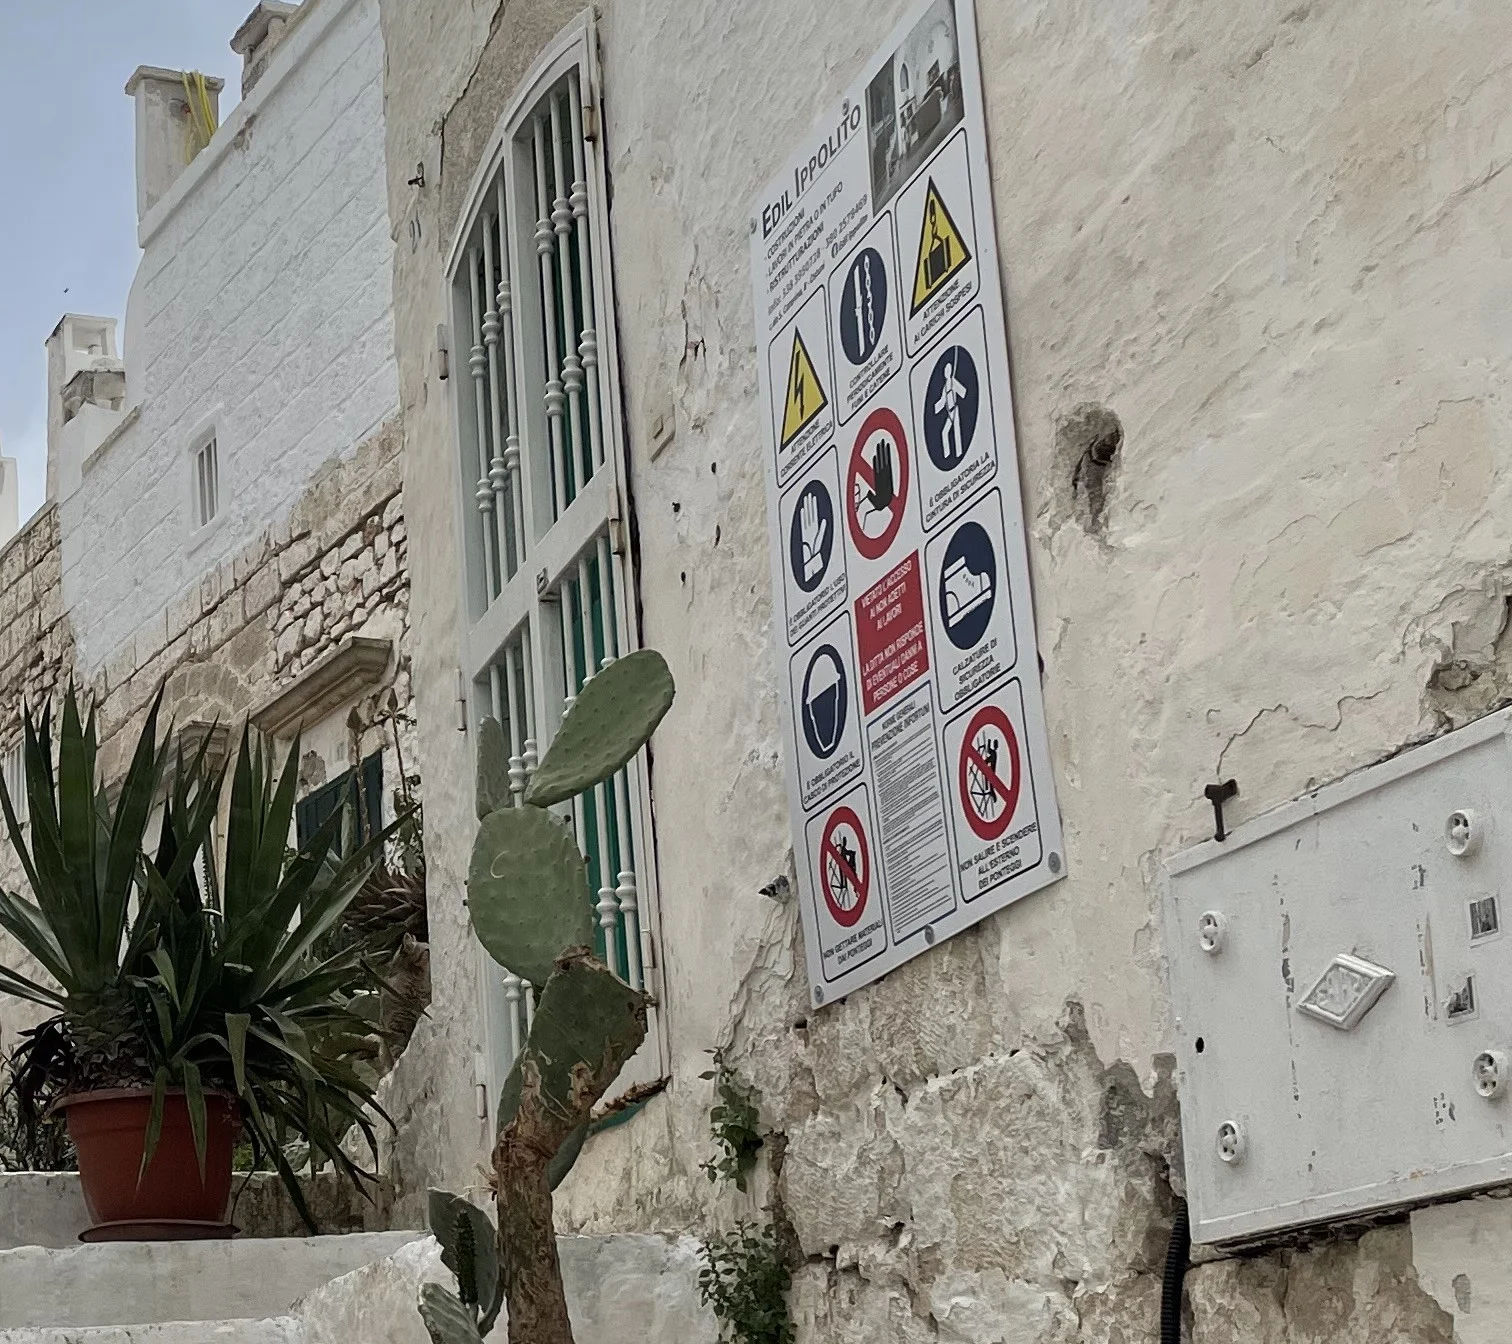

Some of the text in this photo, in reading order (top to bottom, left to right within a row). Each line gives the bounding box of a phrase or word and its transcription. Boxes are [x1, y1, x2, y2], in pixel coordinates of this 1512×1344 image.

[767, 208, 804, 260] COSTRUZIONI
[768, 248, 787, 277] LAVORI
[787, 240, 793, 254] IN
[794, 216, 813, 246] PIETRA
[819, 200, 826, 215] IN
[826, 180, 843, 207] TUFO
[769, 221, 824, 293] RISTRUTTURAZIONI
[913, 278, 972, 345] AI CARICHI SOSPESI
[922, 275, 960, 322] ATTENZIONE
[846, 350, 893, 405] PERIODICAMENTE
[849, 343, 888, 390] CONTROLLARE
[851, 392, 863, 412] FUNI
[868, 365, 890, 394] CATENE
[790, 417, 819, 455] ATTENZIONE
[806, 418, 832, 453] ELETTRICA
[925, 457, 995, 524] CINTURA DI SICUREZZA
[934, 456, 979, 504] OBBLIGATORIA
[979, 448, 989, 465] LA
[861, 582, 882, 610] VIETATO
[882, 600, 902, 627] LAVORI
[895, 618, 923, 651] RISPONDE
[872, 654, 900, 687] EVENTUALI
[952, 636, 997, 677] CALZATURE DI
[958, 652, 994, 686] SICUREZZA
[872, 674, 898, 704] PERSONE
[902, 658, 918, 681] COSE
[954, 661, 1001, 702] OBBLIGATORIE
[827, 757, 860, 788] PROTEZIONE
[959, 857, 973, 873] NON
[973, 843, 995, 865] SALIRE
[1001, 820, 1036, 850] SCENDERE
[978, 857, 1022, 890] DEI PONTEGGI
[834, 933, 857, 953] GETTARE
[847, 937, 872, 959] PONTEGGI
